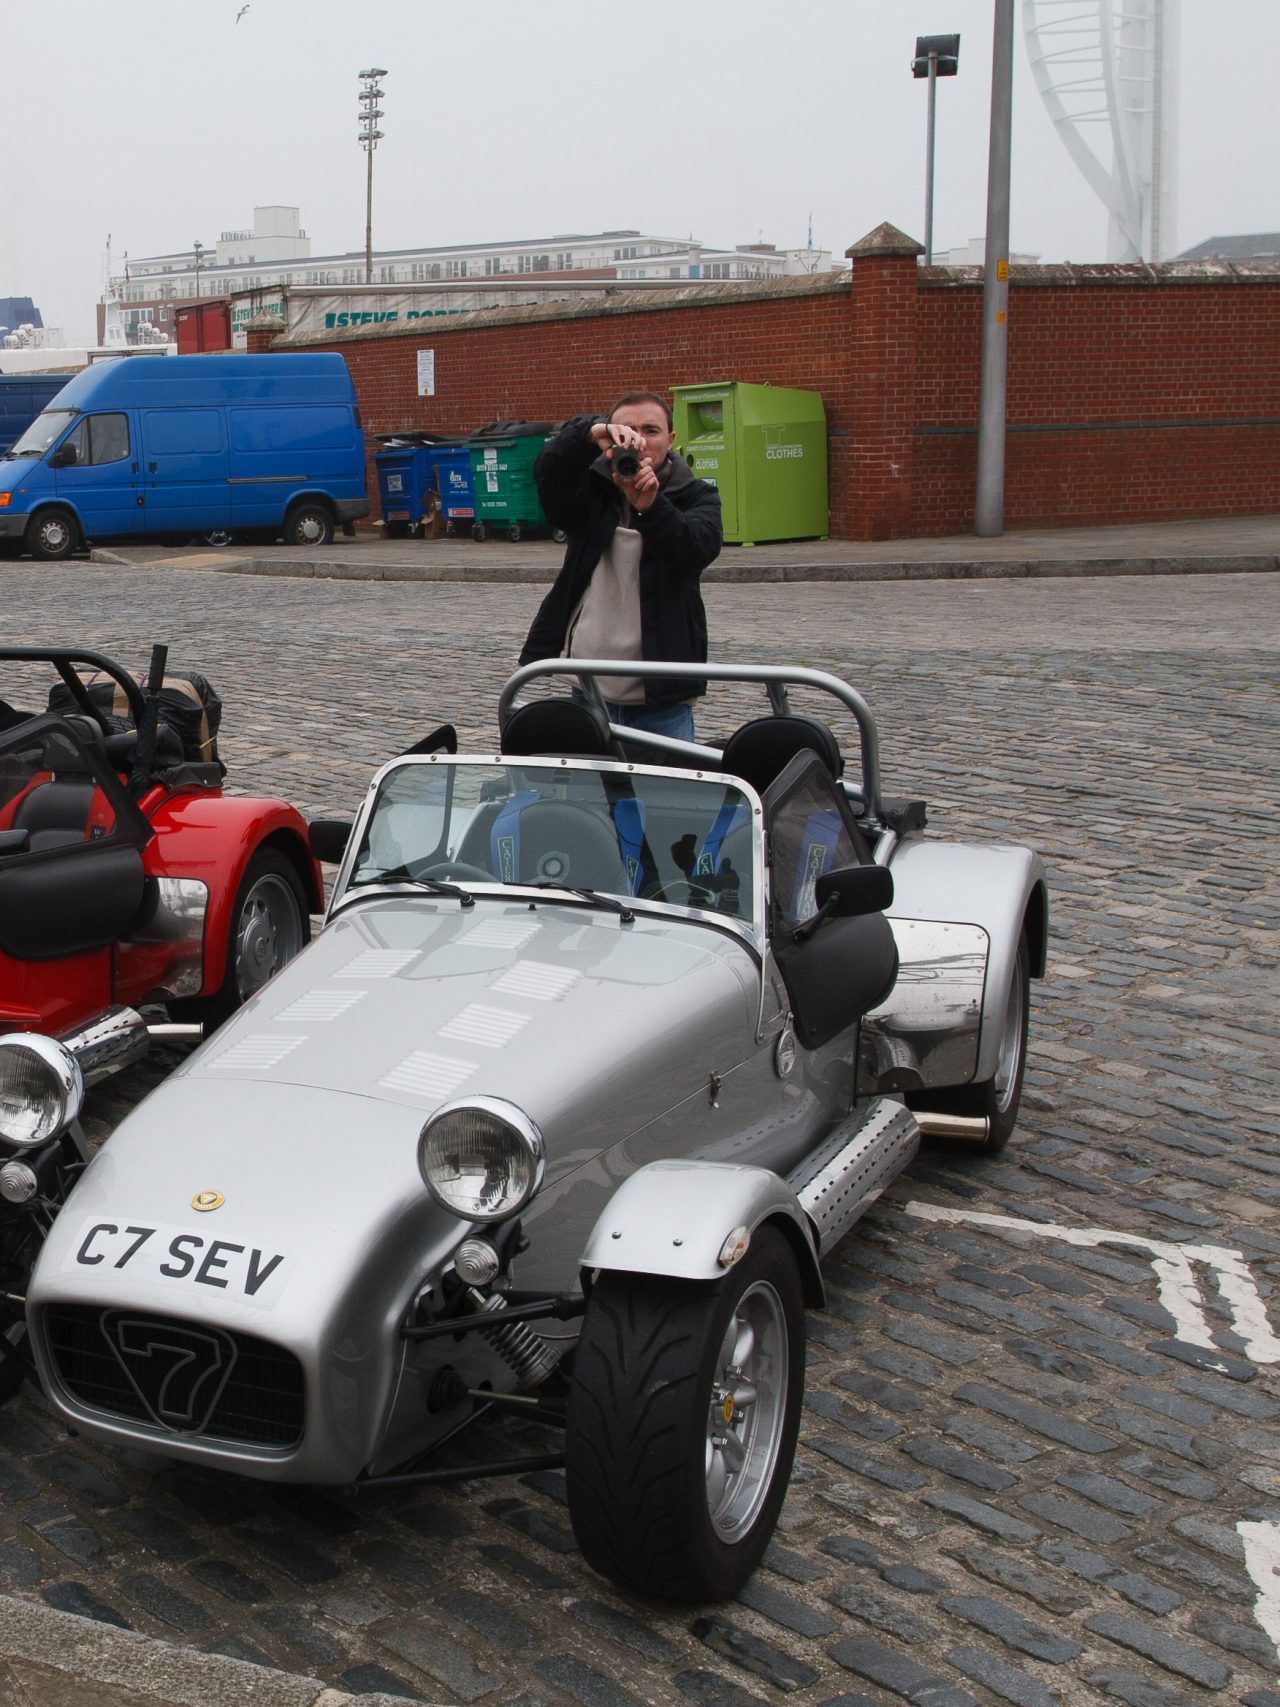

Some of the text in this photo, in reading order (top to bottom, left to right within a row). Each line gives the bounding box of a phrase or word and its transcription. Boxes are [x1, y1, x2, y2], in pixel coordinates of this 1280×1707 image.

[696, 458, 719, 470] CLOTHES
[767, 448, 804, 460] CLOTHES
[76, 1224, 285, 1296] C7 SEV
[118, 1320, 221, 1421] 7
